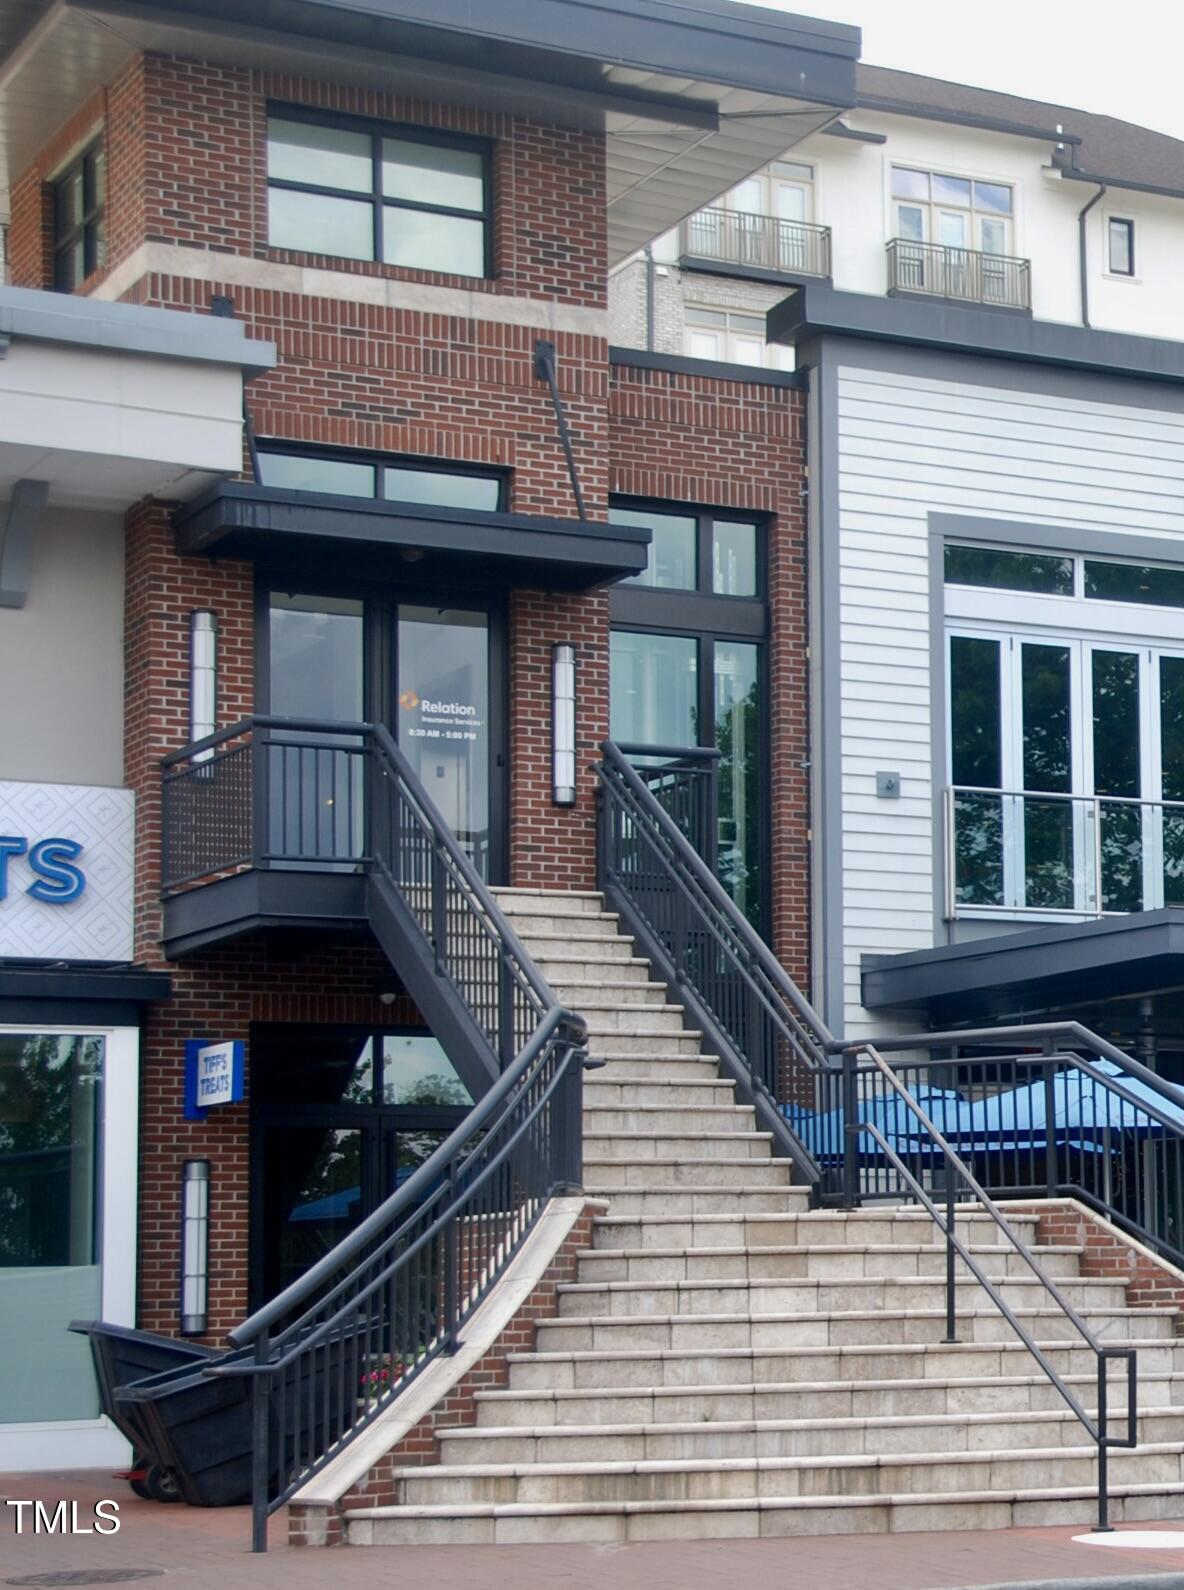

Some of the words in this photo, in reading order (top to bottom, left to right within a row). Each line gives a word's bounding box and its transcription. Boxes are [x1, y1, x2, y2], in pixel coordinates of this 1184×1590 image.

[422, 700, 475, 715] Relation
[427, 729, 440, 738] AM
[464, 732, 477, 741] PM
[201, 1075, 229, 1096] TREATS
